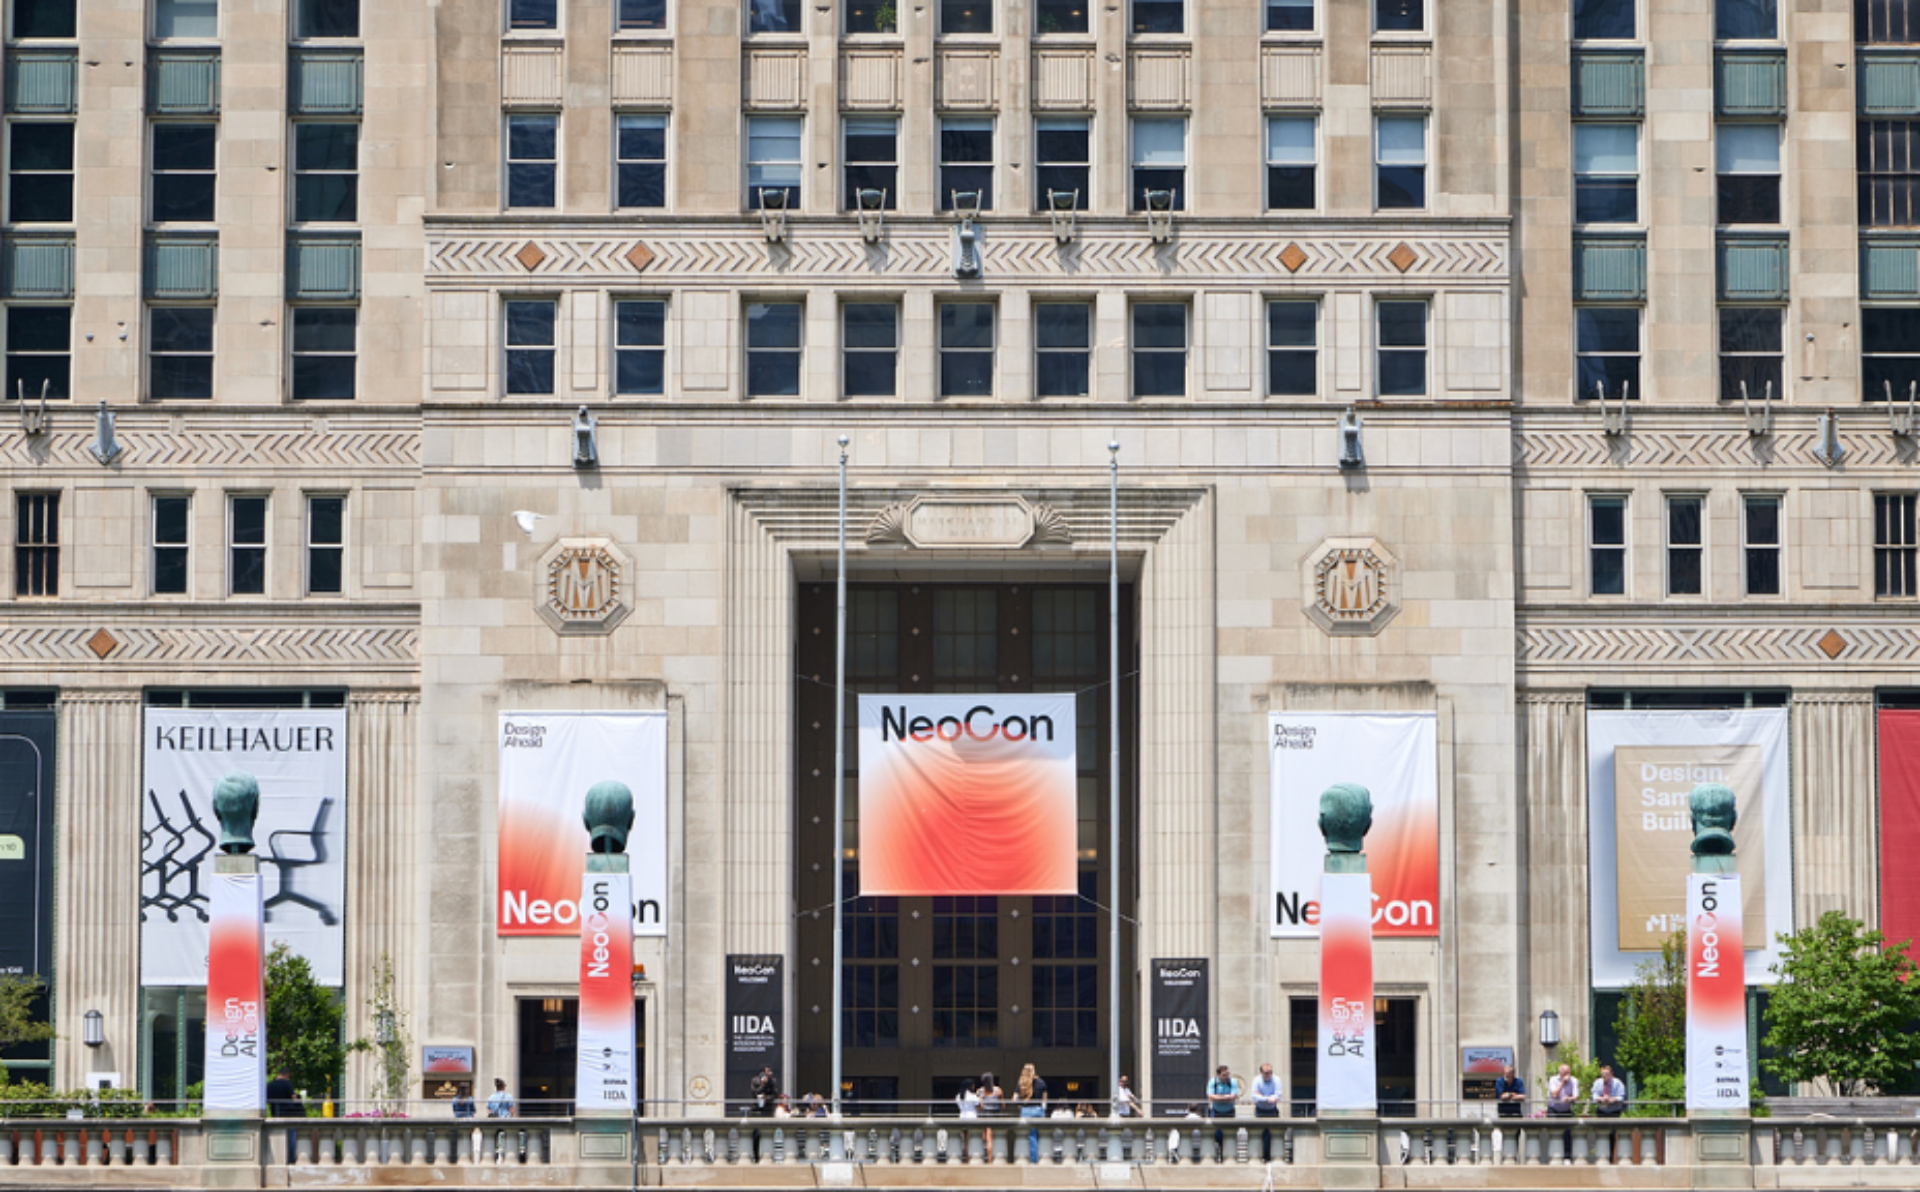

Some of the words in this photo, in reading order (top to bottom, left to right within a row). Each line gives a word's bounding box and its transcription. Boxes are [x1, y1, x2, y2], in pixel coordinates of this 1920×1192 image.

[504, 722, 547, 738] Design
[881, 705, 1054, 742] NeoCon
[1274, 724, 1317, 739] Design
[156, 726, 334, 751] KEILHAUER
[504, 736, 543, 748] Ahead
[1274, 737, 1314, 749] Ahead
[1641, 763, 1731, 785] Design.
[1641, 788, 1691, 807] Sam
[1641, 811, 1694, 831] Buil
[587, 881, 610, 977] NeoCon
[1696, 882, 1719, 977] NeoCon
[734, 965, 775, 975] NeoCon
[1160, 967, 1201, 978] NeoCon
[221, 997, 243, 1057] Design
[240, 1001, 257, 1058] Ahead
[733, 1015, 775, 1033] IIDA
[1158, 1018, 1200, 1036] IIDA
[1328, 997, 1350, 1057] Design
[1346, 1001, 1364, 1058] Ahead
